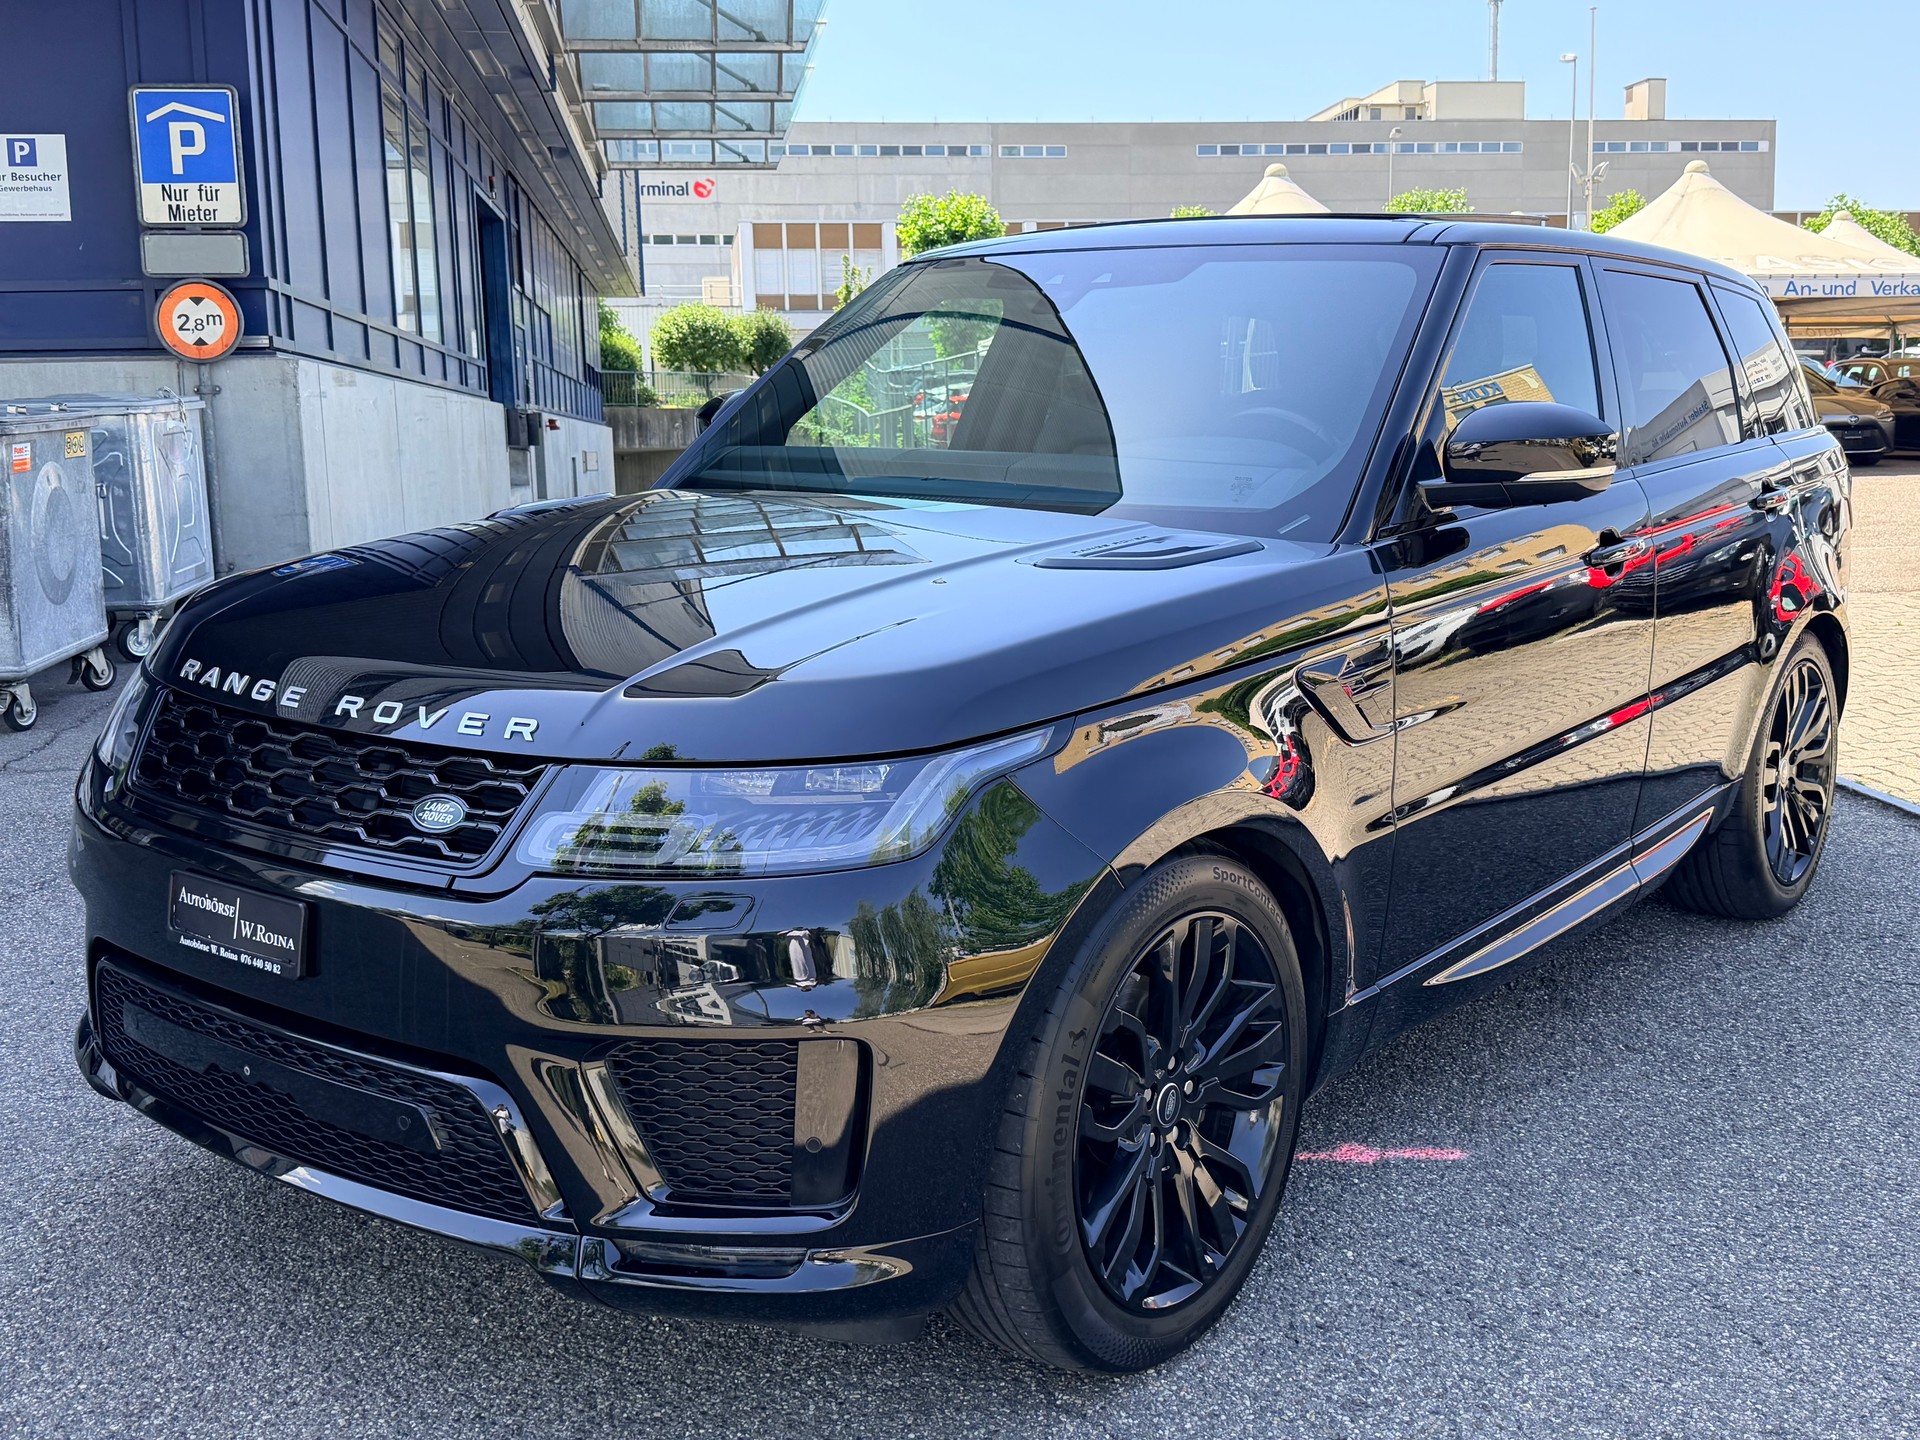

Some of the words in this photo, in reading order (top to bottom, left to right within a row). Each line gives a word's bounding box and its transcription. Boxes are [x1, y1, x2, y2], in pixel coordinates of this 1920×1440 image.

[14, 141, 30, 164] P
[168, 121, 207, 175] P
[11, 172, 62, 181] Besucher
[161, 184, 189, 202] Nur
[197, 184, 221, 202] für
[168, 204, 218, 222] Mieter
[179, 658, 307, 708] RANGE
[335, 695, 539, 742] ROVER
[423, 801, 451, 813] LAND
[421, 811, 454, 824] ROVER
[1212, 866, 1285, 930] SportContact
[179, 935, 210, 952] Autobörse
[210, 944, 219, 955] W.
[219, 946, 239, 961] Roina
[240, 953, 252, 966] 076
[252, 957, 264, 969] 440
[264, 960, 272, 972] 50
[272, 963, 281, 974] 82
